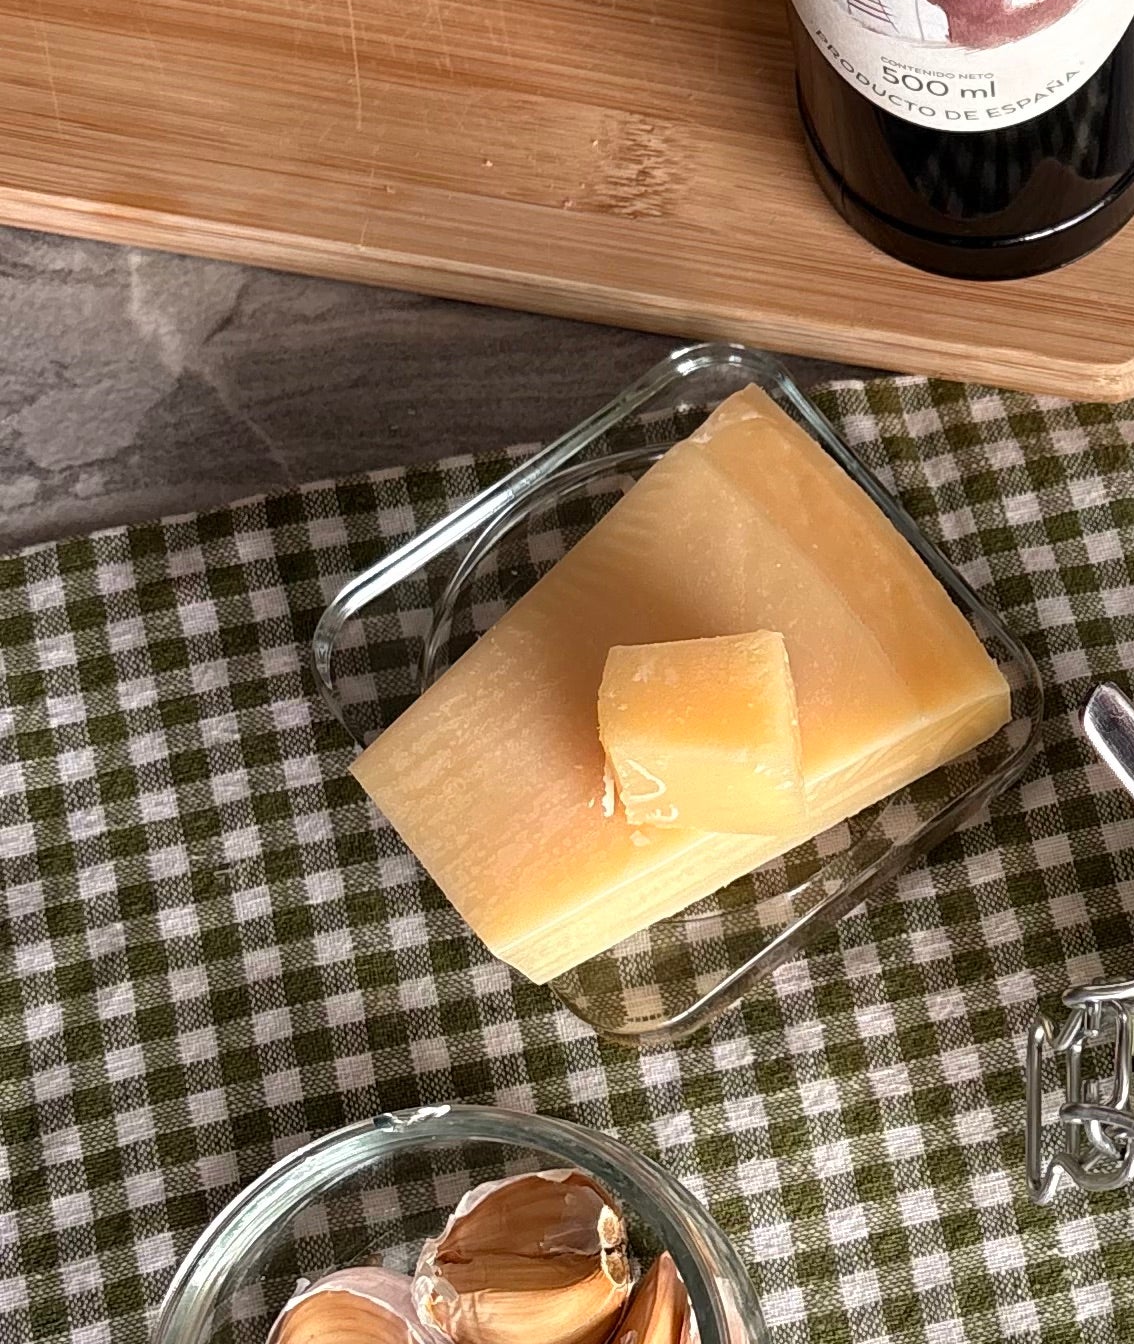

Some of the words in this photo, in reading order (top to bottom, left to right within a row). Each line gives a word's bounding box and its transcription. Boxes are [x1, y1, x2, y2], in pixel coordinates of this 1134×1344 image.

[815, 29, 937, 117] PRODUCTO
[944, 109, 980, 121] DE
[985, 69, 1081, 119] ESPAÑA
[880, 55, 955, 80] CONTENIDO
[958, 71, 995, 81] NETO
[882, 65, 950, 97] 500
[960, 79, 996, 99] ml
